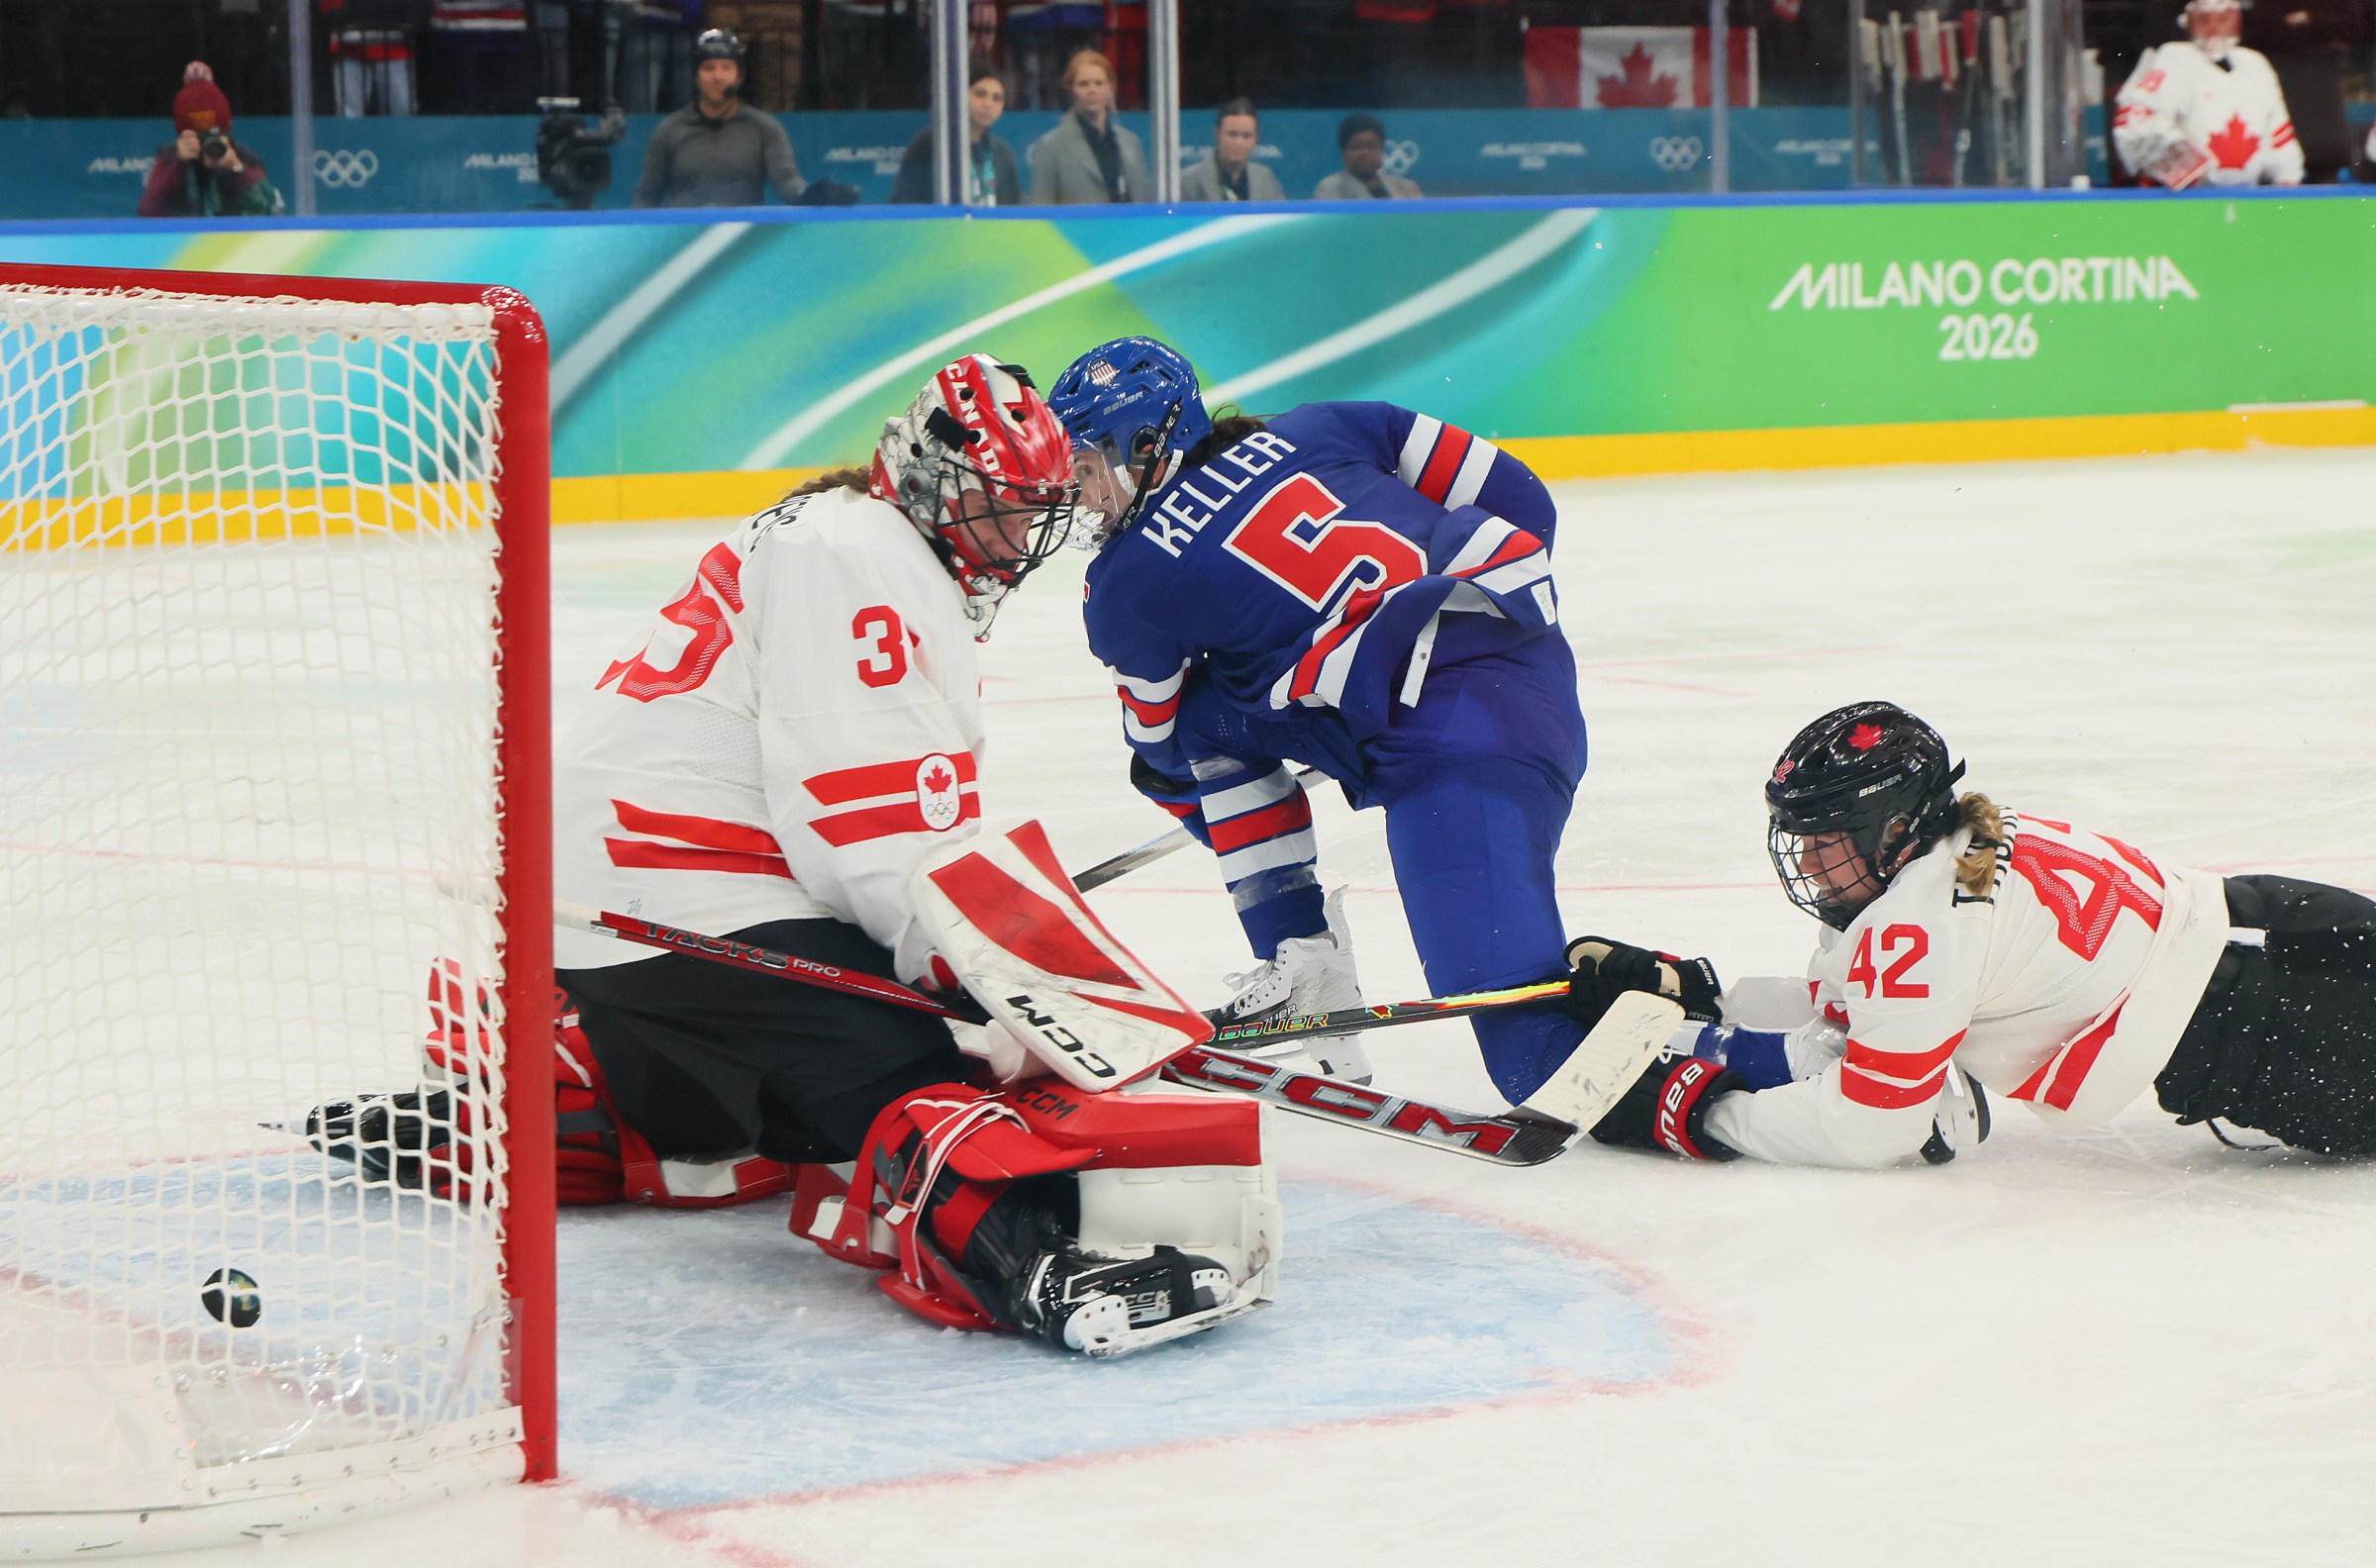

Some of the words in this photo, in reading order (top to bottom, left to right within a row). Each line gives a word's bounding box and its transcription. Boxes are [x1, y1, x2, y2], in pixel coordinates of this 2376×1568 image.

[1769, 259, 1982, 311] MILANO
[1989, 255, 2200, 305] CORTINA
[1090, 360, 1106, 372] USA
[1938, 313, 2039, 361] 2026
[1140, 431, 1297, 558] KELLER
[1221, 471, 1429, 620] 5
[637, 920, 790, 970] TACKS
[792, 957, 842, 978] PRO
[1846, 923, 1930, 1000] 42
[1006, 994, 1117, 1078] CCM
[1218, 1013, 1330, 1040] BAUER
[1016, 1086, 1079, 1121] CCM
[1162, 1047, 1521, 1156] CCM
